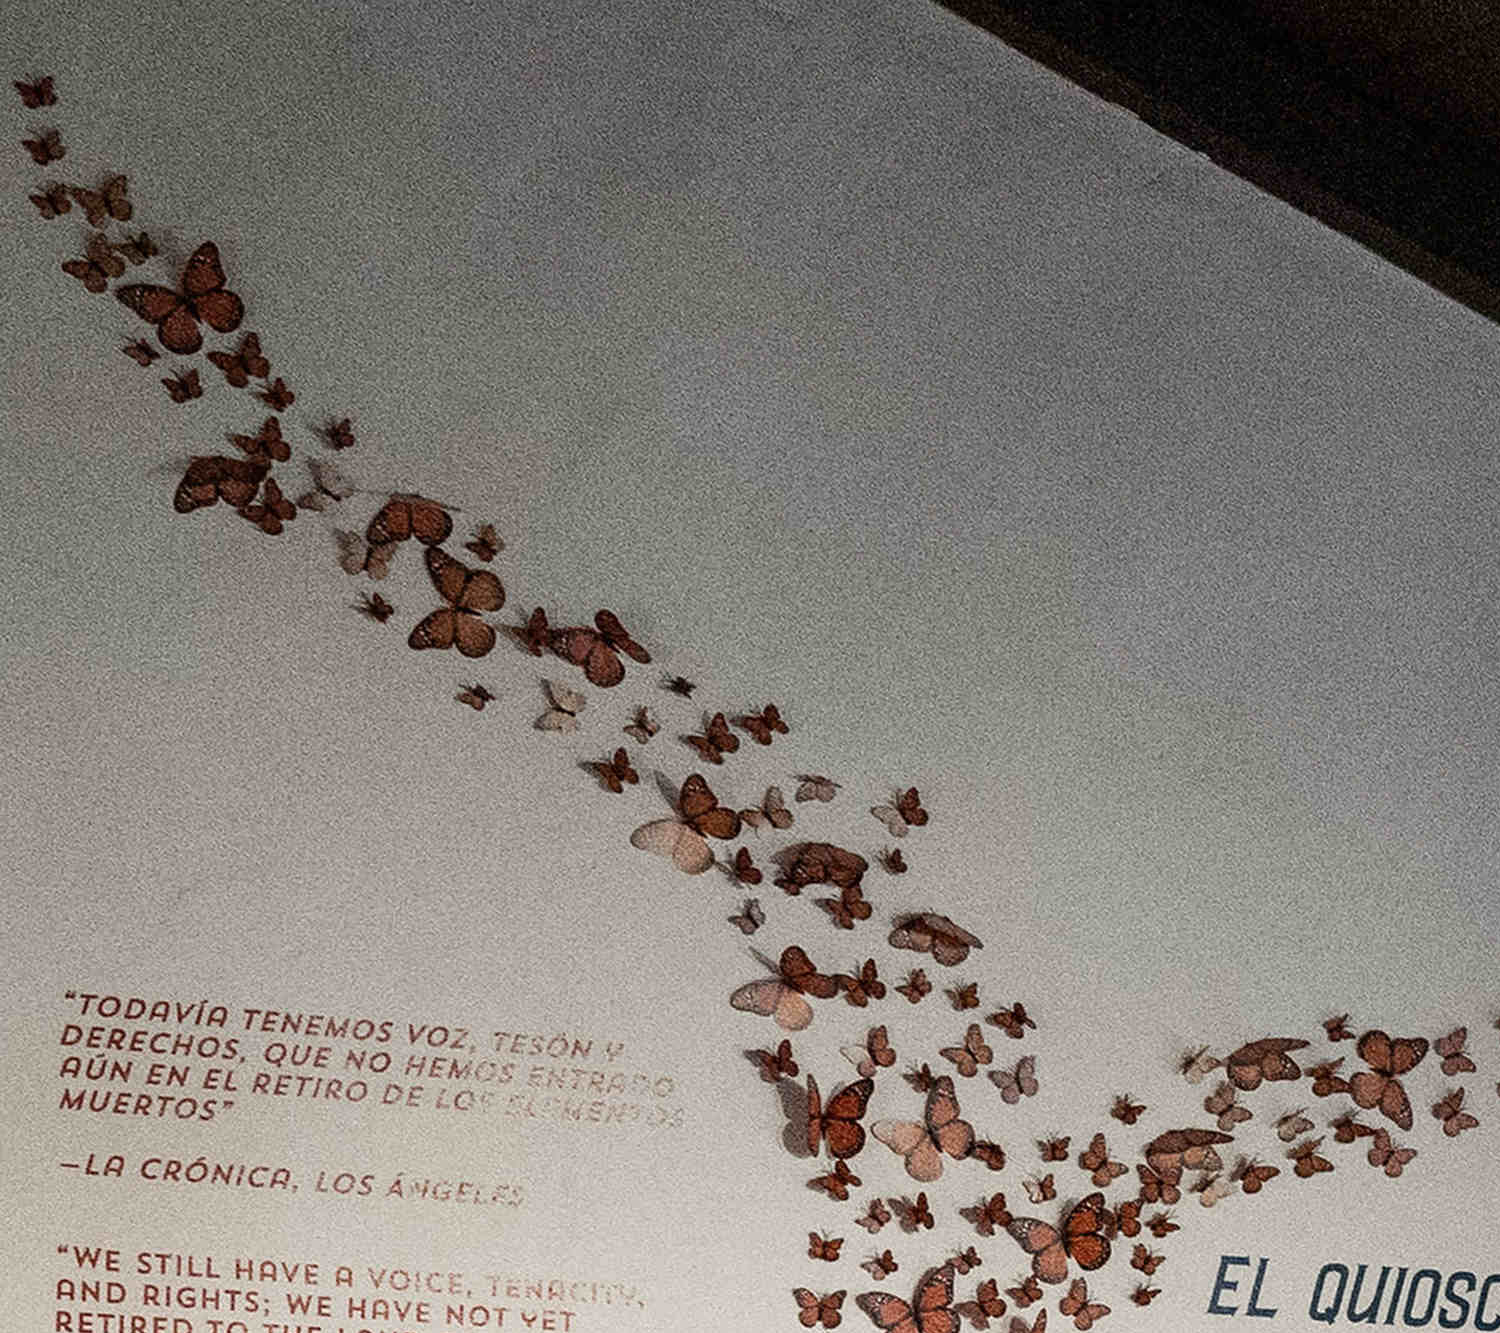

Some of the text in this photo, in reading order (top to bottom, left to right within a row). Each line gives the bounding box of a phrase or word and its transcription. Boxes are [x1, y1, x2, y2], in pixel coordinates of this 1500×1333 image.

[64, 990, 229, 1028] “TODAVÍA
[243, 1008, 394, 1043] TENEMOS
[408, 1023, 478, 1052] VOZ,
[492, 1029, 594, 1059] TESÓN
[59, 1023, 246, 1064] DERECHOS,
[263, 1042, 332, 1069] QUE
[346, 1050, 392, 1074] NO
[404, 1054, 518, 1086] HEMOS
[59, 1053, 133, 1083] AÚN
[145, 1063, 191, 1087] EN
[202, 1068, 238, 1093] EL
[251, 1072, 369, 1103] RETIRO
[381, 1084, 422, 1108] DE
[58, 1088, 235, 1122] MUERTOS”
[139, 1156, 298, 1191] CRÓNICA,
[315, 1171, 376, 1197] LOS
[56, 1245, 121, 1273] “WE
[136, 1251, 221, 1279] STILL
[234, 1258, 319, 1286] HAVE
[334, 1265, 354, 1288] A
[366, 1266, 474, 1298] VOICE,
[1206, 1254, 1278, 1319] EL
[56, 1278, 574, 1332] AND RIGHTS; WE HAVE NOT YET
